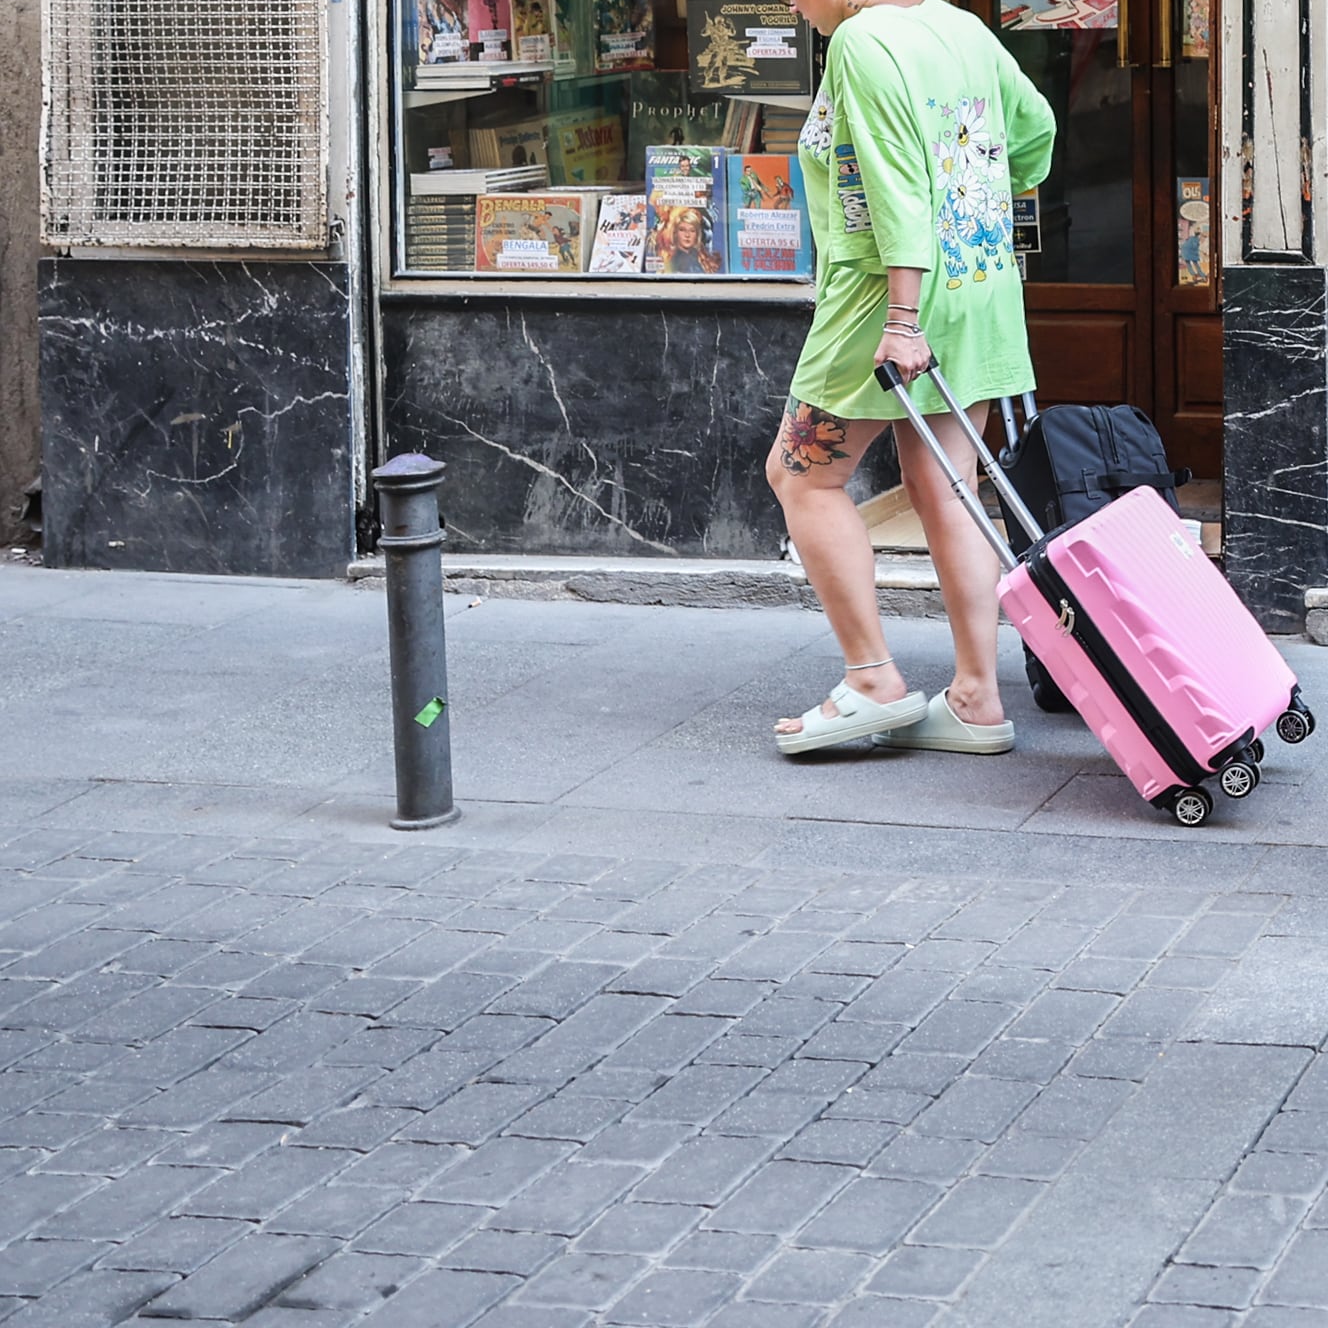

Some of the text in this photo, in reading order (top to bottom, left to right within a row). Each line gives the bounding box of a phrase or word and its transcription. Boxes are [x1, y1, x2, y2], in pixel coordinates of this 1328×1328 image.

[721, 4, 791, 15] JOHNNY COMAND
[713, 156, 719, 169] 1
[480, 199, 546, 227] BENGALA
[503, 240, 548, 251] BENGALA
[746, 238, 777, 247] OFERTA
